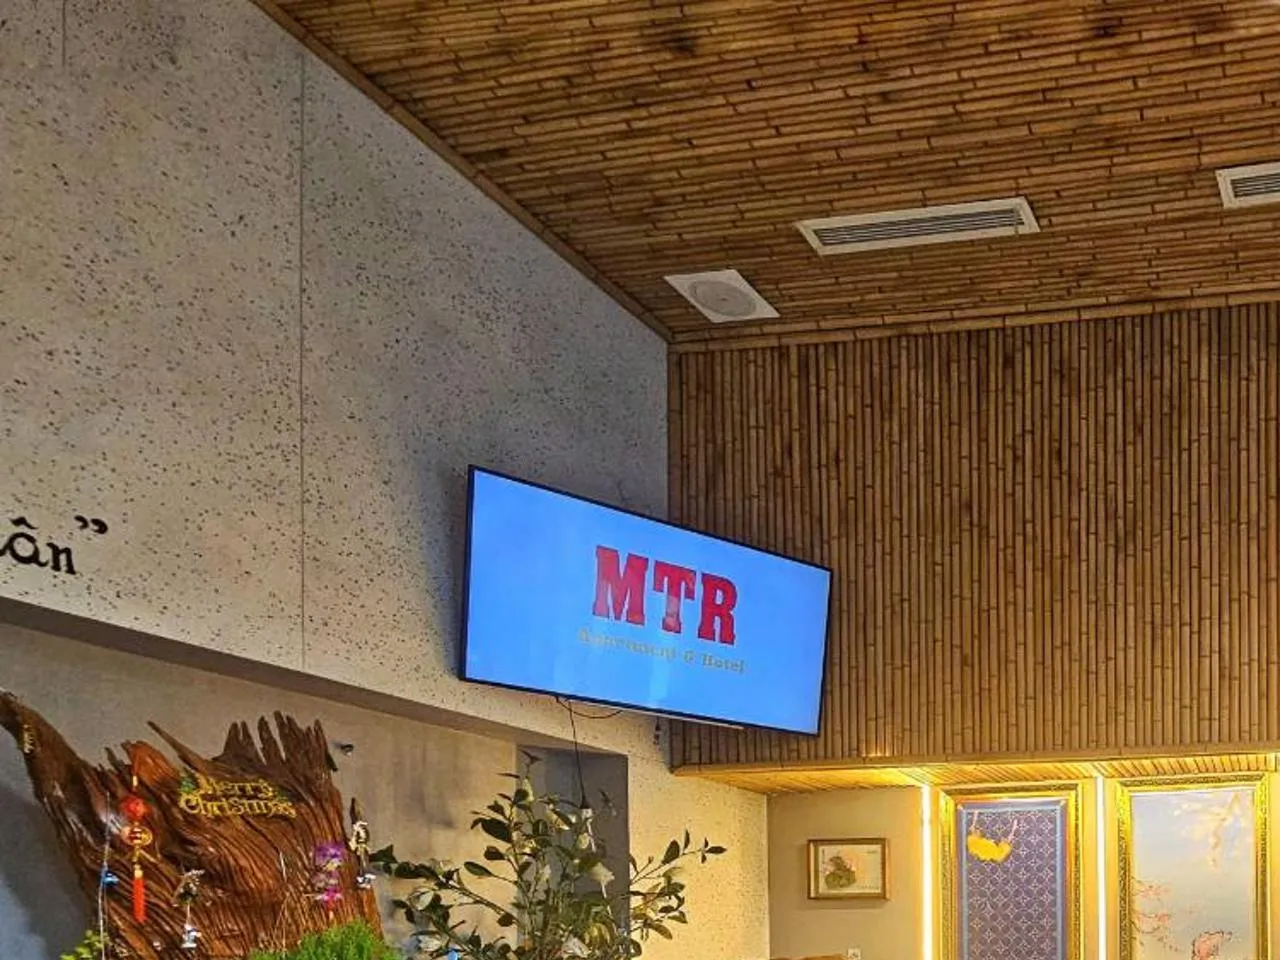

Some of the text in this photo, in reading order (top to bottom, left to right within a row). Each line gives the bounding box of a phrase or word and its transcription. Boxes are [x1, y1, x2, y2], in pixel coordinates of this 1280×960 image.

[0, 516, 108, 575] ân”
[592, 545, 737, 645] MTR
[178, 792, 298, 819] Christmas
[202, 778, 274, 799] Merry
